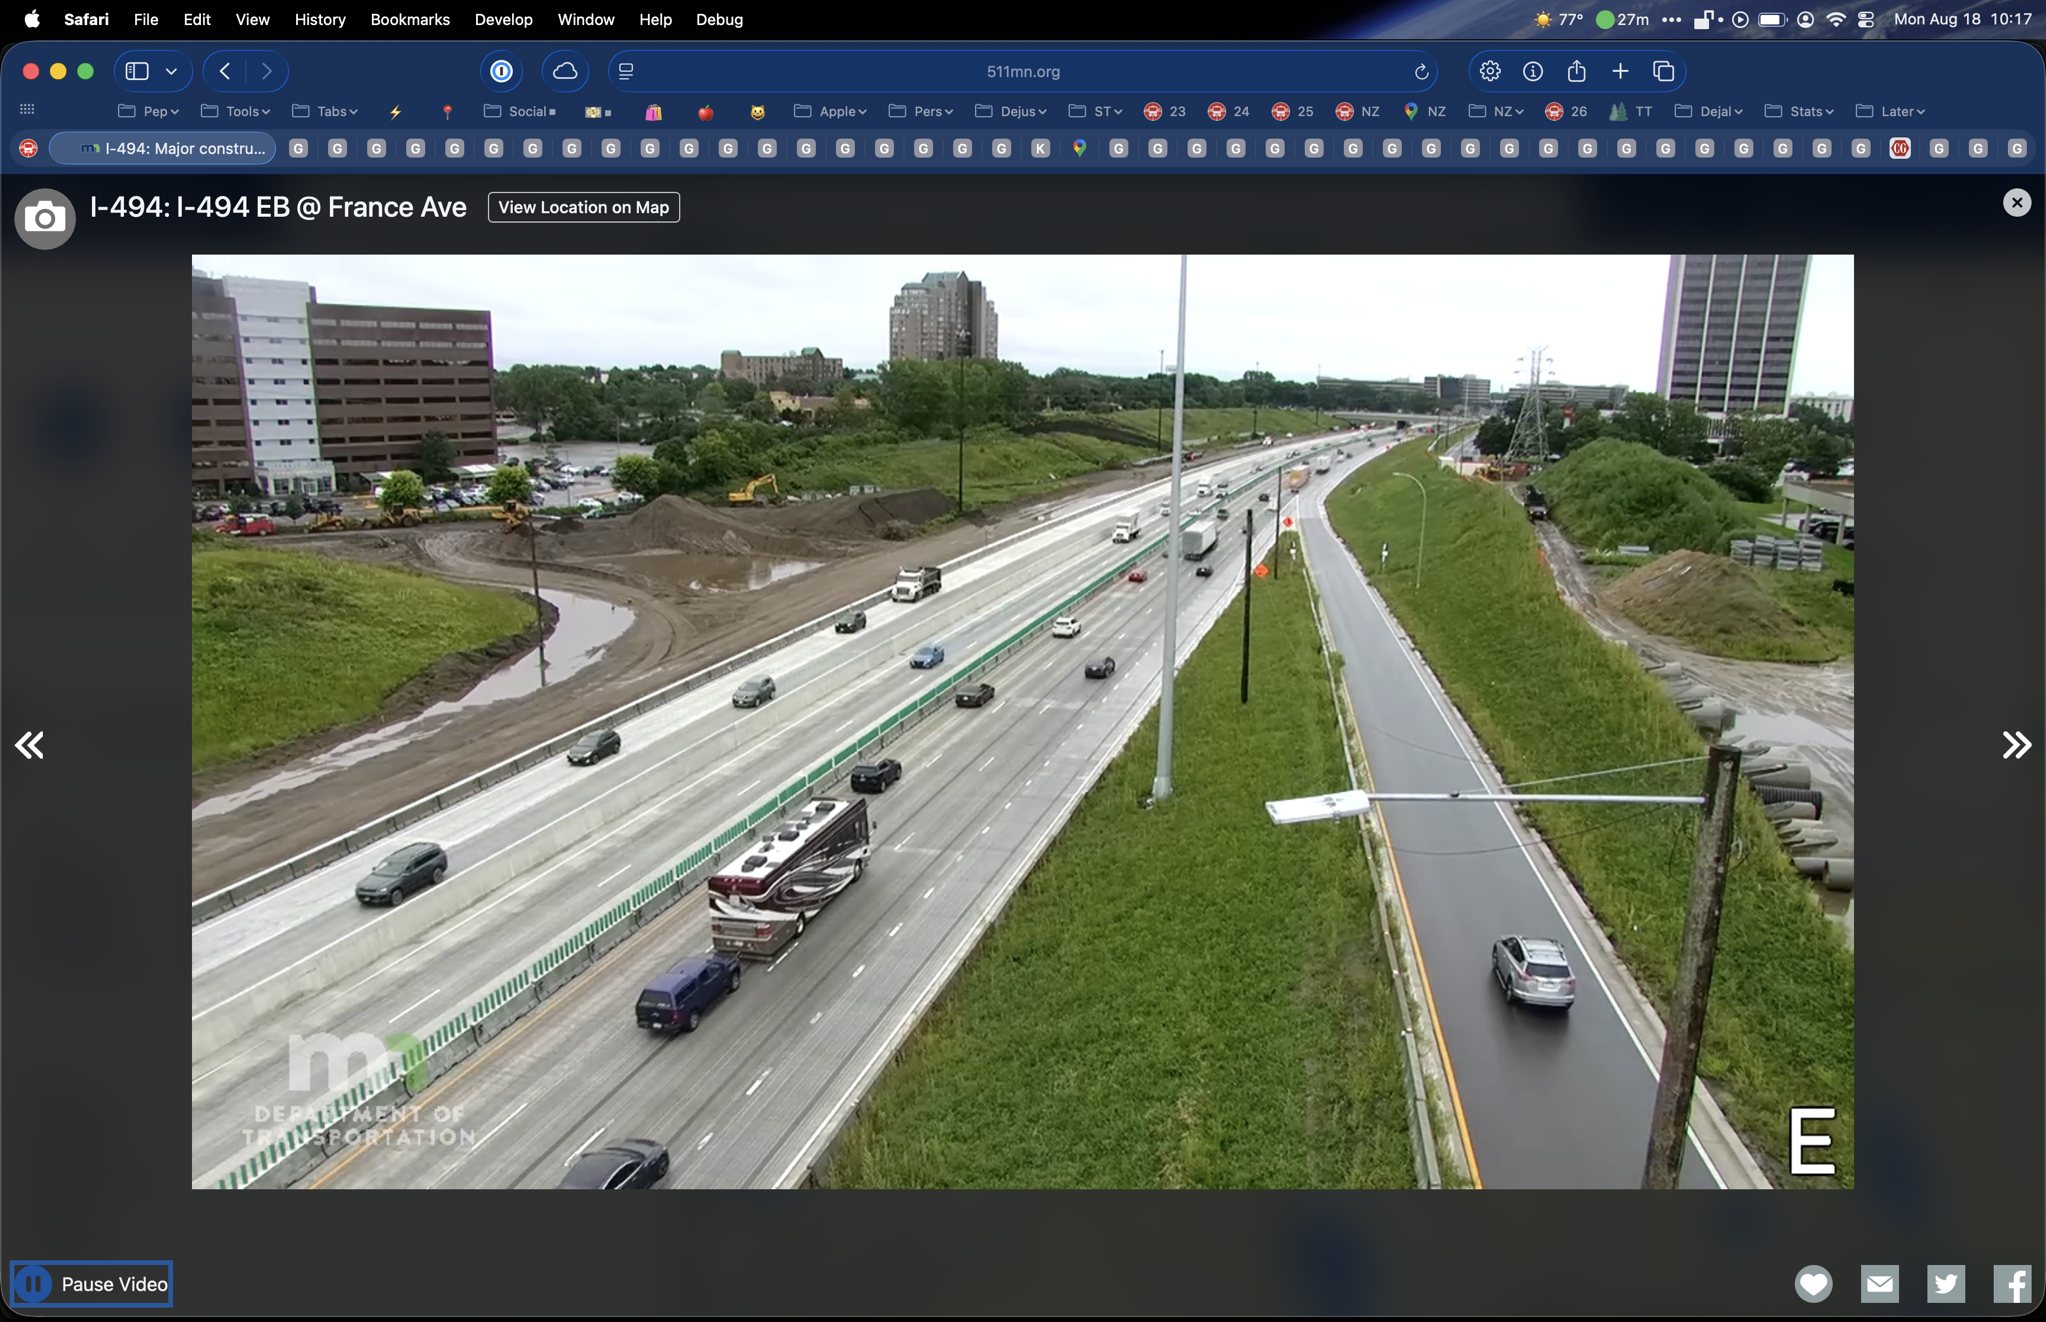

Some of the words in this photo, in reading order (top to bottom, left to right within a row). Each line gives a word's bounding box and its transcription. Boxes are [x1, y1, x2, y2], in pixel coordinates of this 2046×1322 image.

[64, 12, 110, 26] Safari
[135, 13, 159, 26] File
[184, 13, 211, 26] Edit
[236, 13, 271, 26] View
[295, 13, 347, 28] History
[371, 13, 450, 26] Bookmarks
[475, 13, 533, 28] Develop
[557, 13, 616, 26] Window
[640, 13, 672, 28] Help
[697, 13, 743, 28] Debug
[1558, 13, 1584, 26] 77°
[1617, 13, 1649, 26] 27m
[1894, 13, 1925, 26] Mon
[1929, 13, 1958, 28] Aug
[1963, 13, 1981, 26] 18
[1991, 13, 2032, 26] 10:17
[987, 65, 1061, 81] 511mn.org
[144, 105, 168, 120] Pep
[226, 105, 260, 118] Tools
[317, 105, 347, 118] Tabs
[509, 105, 548, 118] Social
[819, 105, 856, 120] Apple
[915, 105, 942, 118] Pers
[1001, 105, 1036, 120] Dejus
[1094, 105, 1112, 118] ST
[1169, 105, 1186, 118] 23
[1233, 105, 1250, 118] 24
[1297, 105, 1314, 118] 25
[1361, 105, 1380, 118] NZ
[1428, 105, 1447, 118] NZ
[1494, 105, 1513, 118] NZ
[1571, 105, 1588, 118] 26
[1635, 105, 1653, 118] TT
[1701, 105, 1732, 120] Dejal
[1790, 105, 1823, 118] Stats
[1882, 105, 1915, 118] Later
[106, 142, 150, 155] I-494:
[155, 142, 195, 158] Major
[293, 143, 304, 155] G
[332, 143, 343, 155] G
[371, 143, 382, 155] G
[410, 143, 421, 155] G
[449, 143, 460, 155] G
[488, 143, 499, 155] G
[527, 143, 538, 155] G
[566, 143, 577, 155] G
[605, 143, 616, 155] G
[644, 143, 655, 155] G
[684, 143, 695, 155] G
[723, 143, 734, 155] G
[762, 143, 773, 155] G
[801, 143, 812, 155] G
[840, 143, 851, 155] G
[879, 143, 890, 155] G
[918, 143, 929, 155] G
[957, 143, 968, 155] G
[996, 143, 1007, 155] G
[1035, 143, 1046, 155] K
[1113, 143, 1124, 155] G
[1152, 143, 1163, 155] G
[1191, 143, 1202, 155] G
[1230, 143, 1241, 155] G
[1270, 143, 1281, 155] G
[1309, 143, 1320, 155] G
[1348, 143, 1359, 155] G
[1387, 143, 1398, 155] G
[1426, 143, 1437, 155] G
[1465, 143, 1476, 155] G
[1504, 143, 1515, 155] G
[1543, 143, 1554, 155] G
[1582, 143, 1593, 155] G
[1621, 143, 1632, 155] G
[1660, 143, 1671, 155] G
[1699, 143, 1710, 155] G
[1738, 143, 1749, 155] G
[1778, 143, 1789, 155] G
[1817, 143, 1828, 155] G
[1856, 143, 1867, 155] G
[1893, 142, 1907, 154] CG
[1934, 143, 1945, 155] G
[1973, 143, 1984, 155] G
[2012, 143, 2023, 155] G
[91, 195, 170, 218] I-494:
[177, 195, 250, 218] I-494
[257, 195, 291, 218] EB
[296, 195, 322, 221] @
[329, 195, 414, 218] France
[420, 195, 467, 218] Ave
[498, 199, 537, 214] View
[541, 199, 608, 214] Location
[611, 203, 632, 214] on
[636, 200, 670, 217] Map
[62, 1276, 114, 1292] Pause
[118, 1276, 169, 1292] Video
